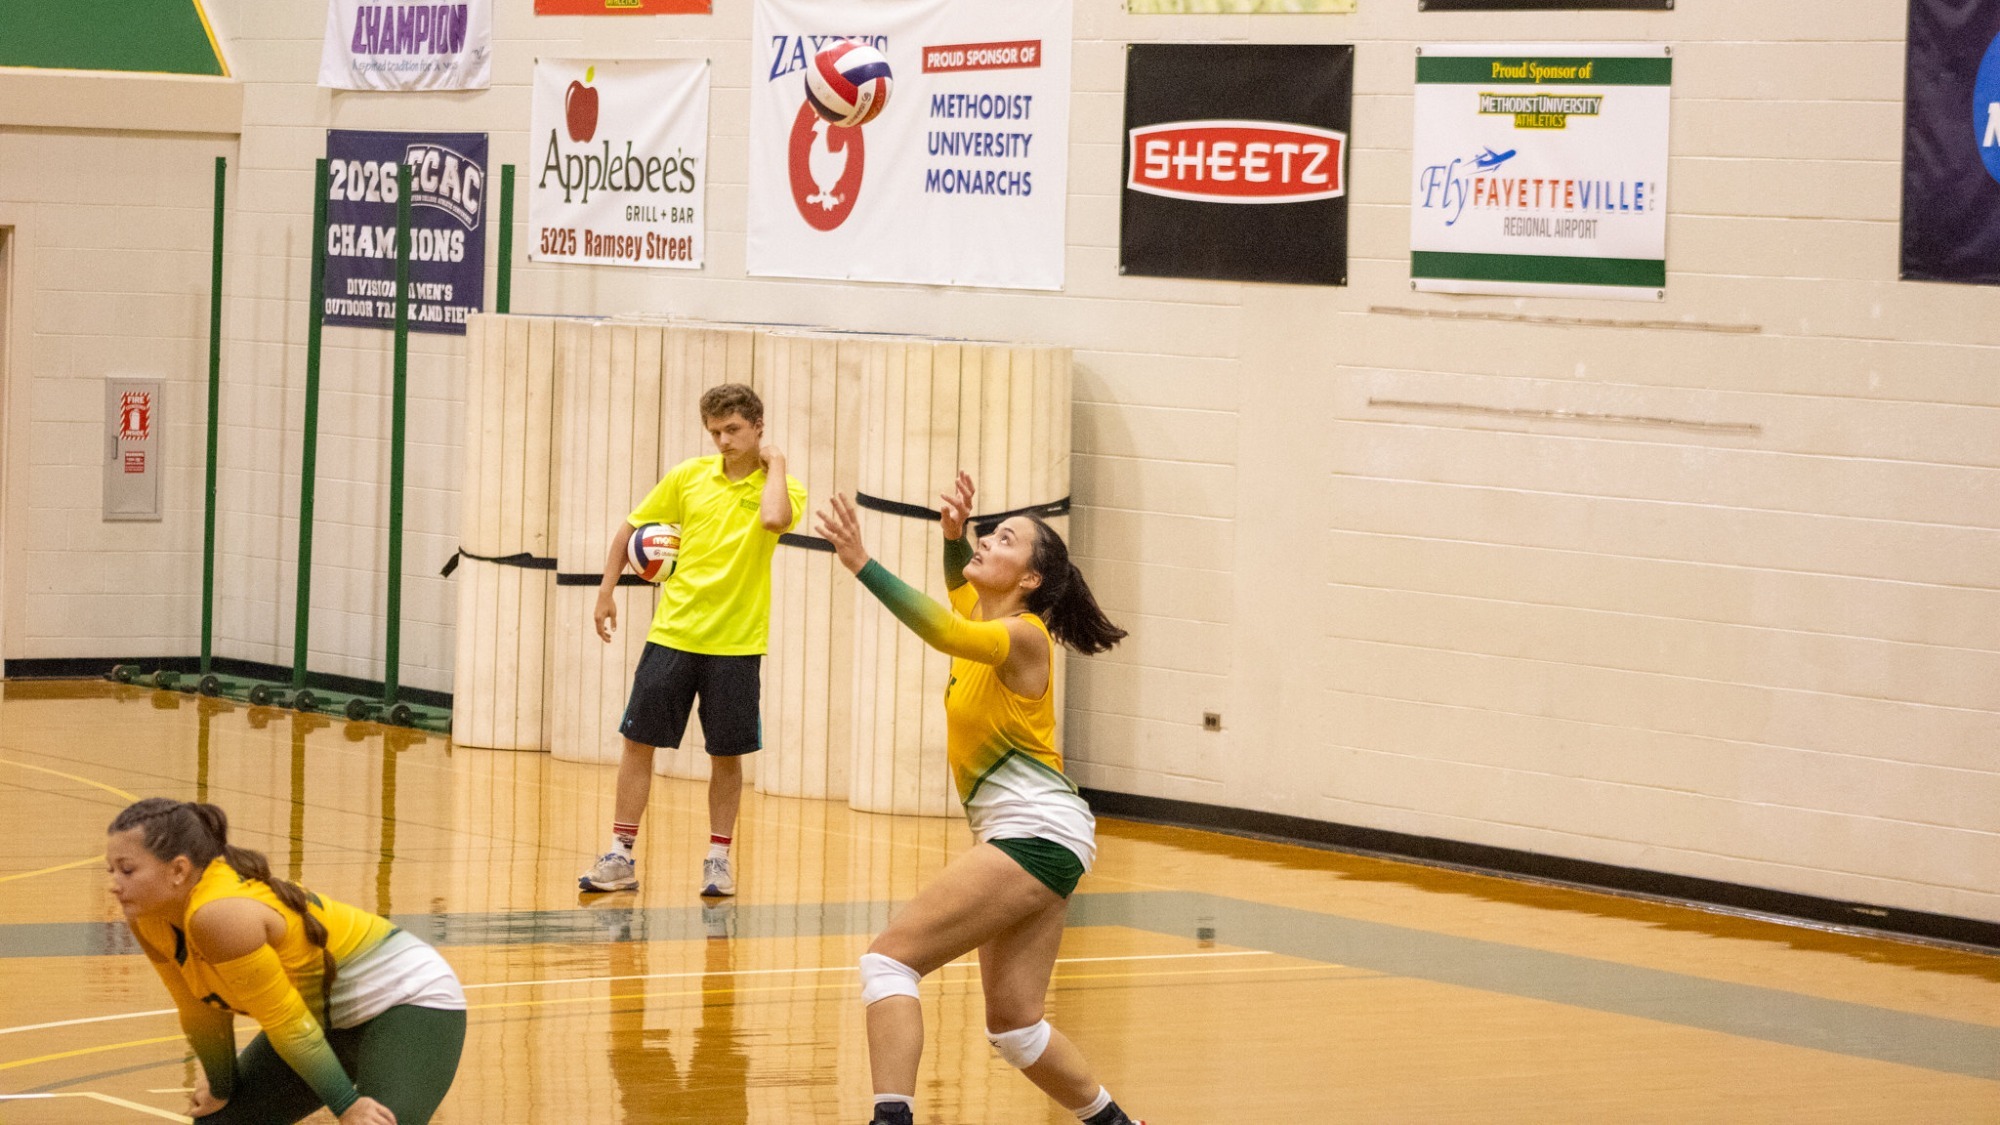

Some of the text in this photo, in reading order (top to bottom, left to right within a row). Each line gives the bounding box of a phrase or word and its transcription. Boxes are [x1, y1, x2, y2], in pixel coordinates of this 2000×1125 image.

[351, 4, 468, 55] CHAMPION
[927, 47, 1036, 68] PROUD SPONSOR OF
[1492, 61, 1593, 84] Proud Sponsor of
[930, 94, 1032, 120] METHODIST
[1515, 114, 1564, 127] ATHLETICS
[928, 131, 1033, 158] UNIVERSITY
[539, 128, 696, 204] Applebee's
[1144, 139, 1329, 184] SHEETZ
[329, 158, 399, 204] 2026
[407, 149, 482, 215] ECAC
[925, 168, 1032, 197] MONARCHS
[1420, 157, 1469, 227] Fly
[1473, 177, 1645, 211] FAYETTEVILLE
[625, 205, 658, 222] GRILL
[671, 207, 694, 224] BAR
[1503, 216, 1598, 239] REGIONAL AIRPORT
[328, 224, 465, 262] CHAMIONS
[540, 227, 693, 262] 5225 Ramsey Street
[416, 282, 453, 301] MEN'S
[325, 298, 373, 317] OUTDOOR
[418, 304, 443, 322] AND
[127, 396, 145, 404] FIRE
